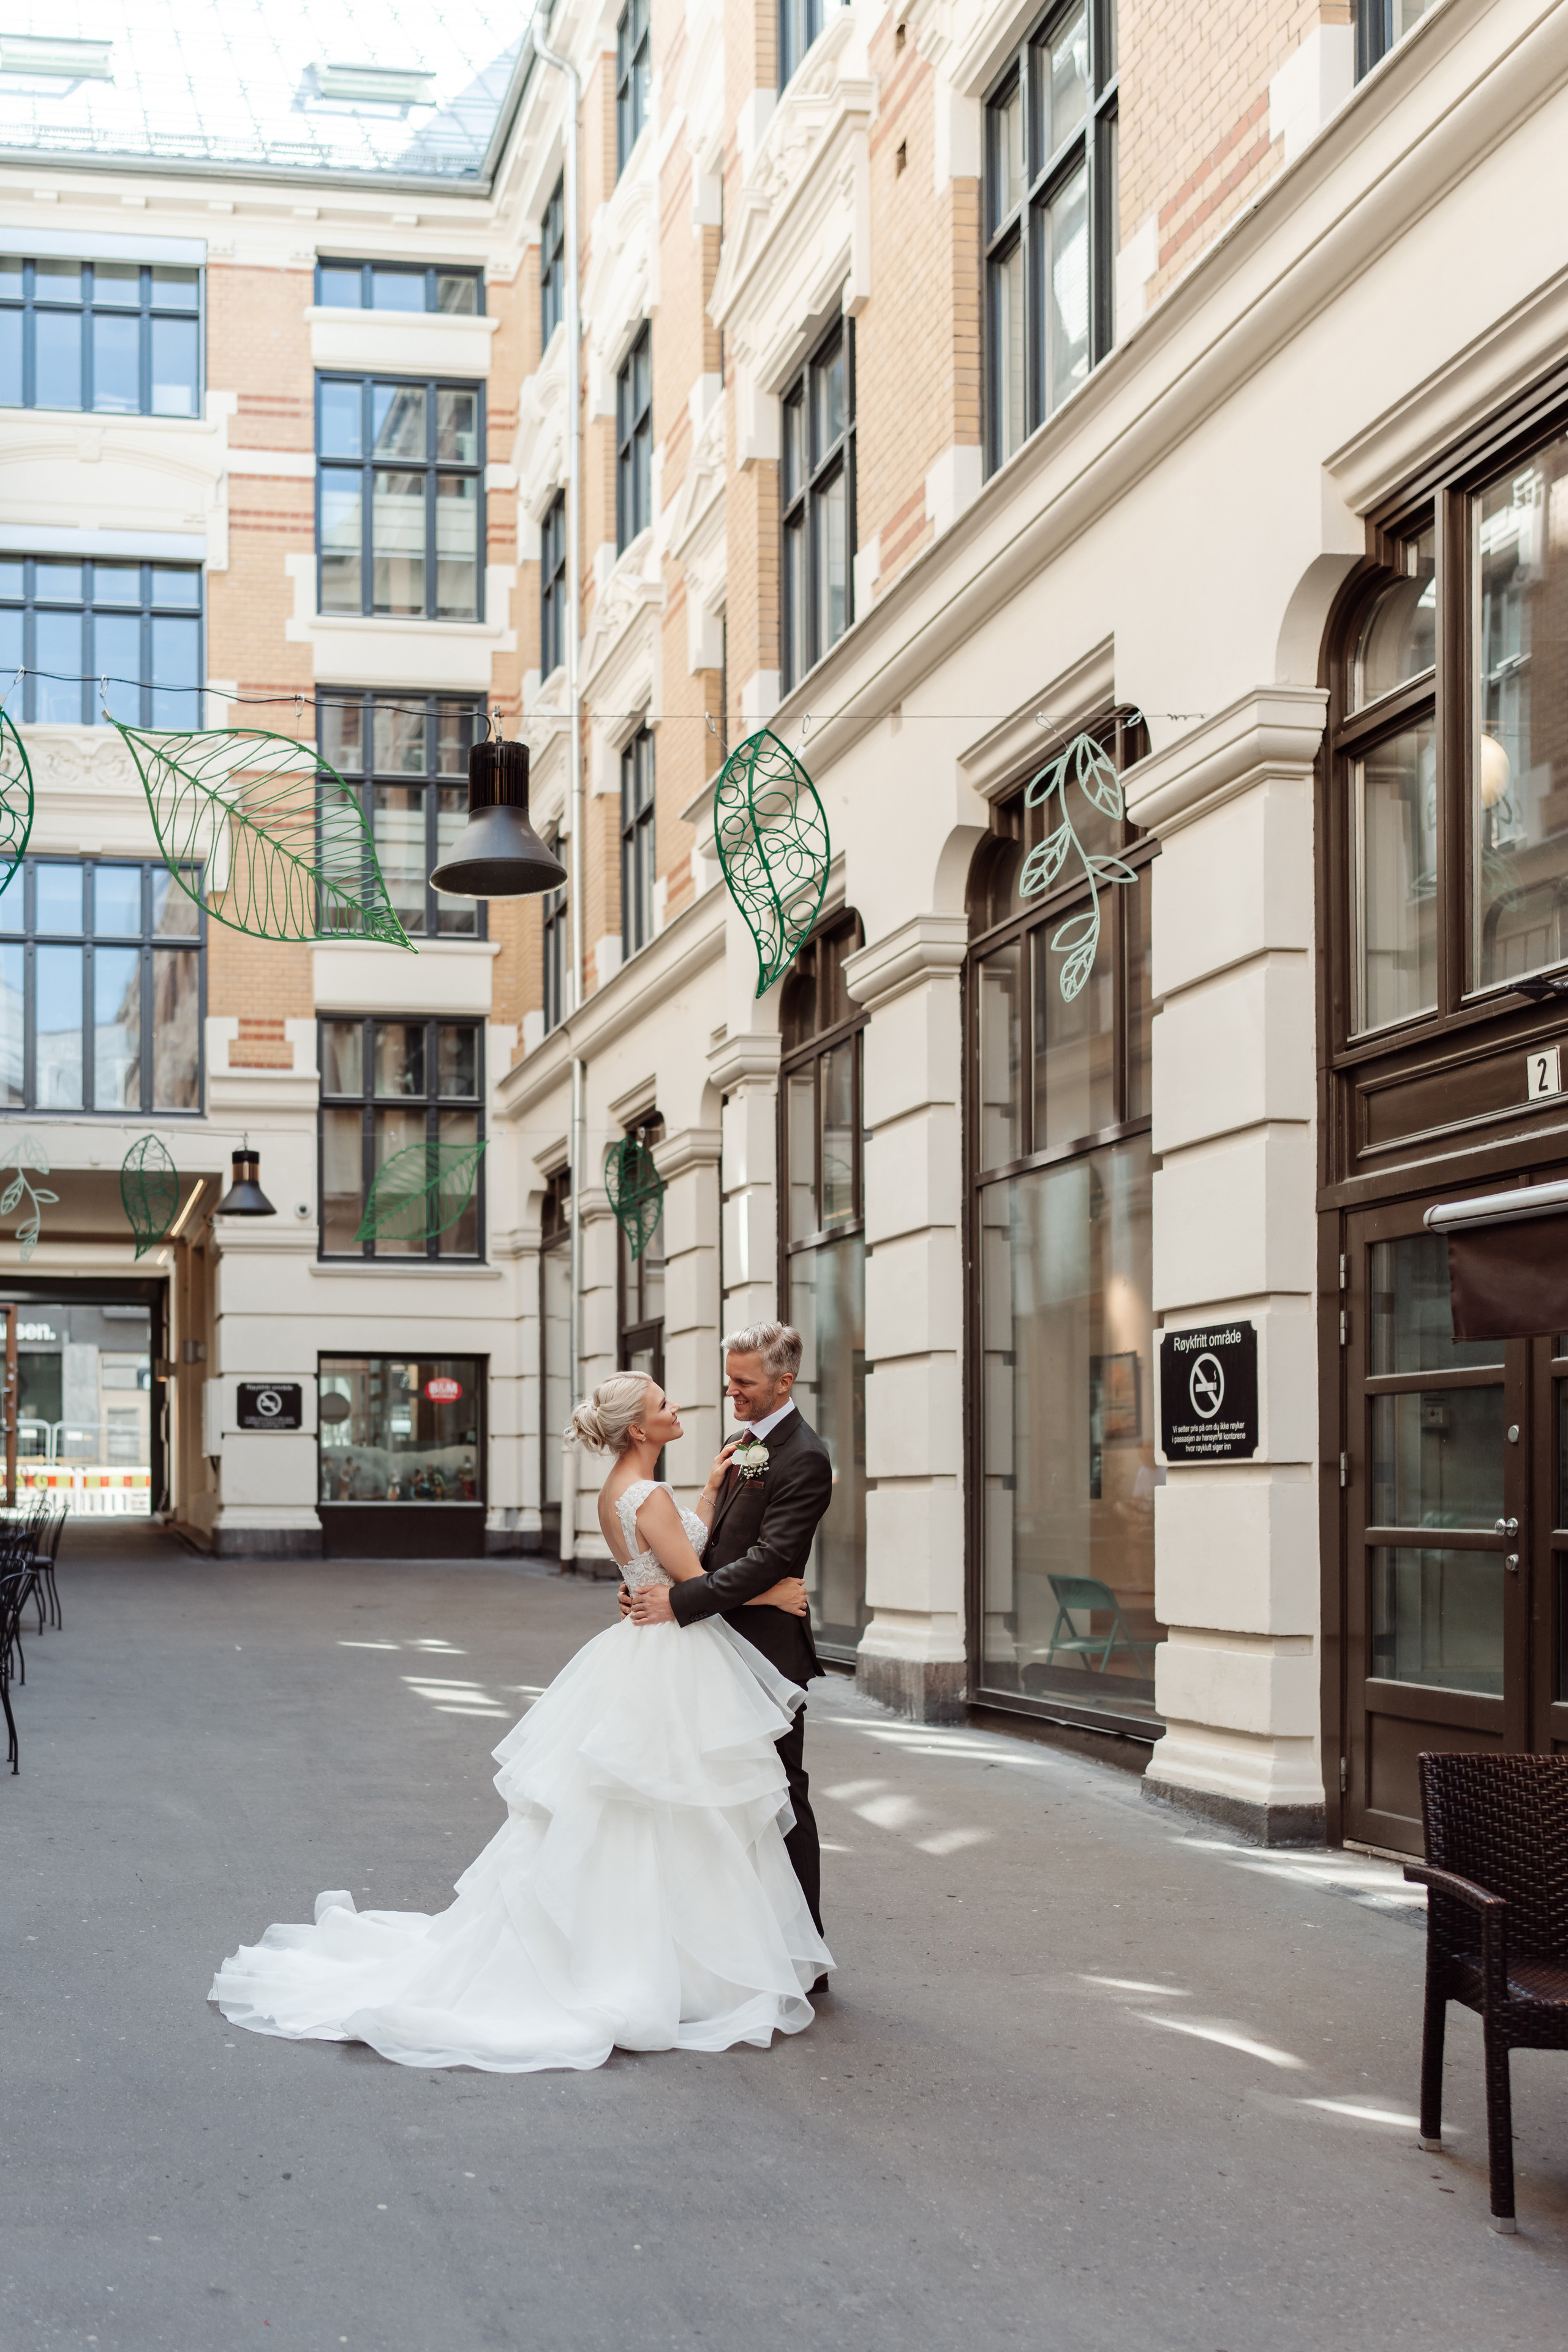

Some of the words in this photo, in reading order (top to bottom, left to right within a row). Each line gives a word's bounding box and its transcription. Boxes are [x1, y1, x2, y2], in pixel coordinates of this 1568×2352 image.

[1537, 1058, 1548, 1091] 2
[1174, 1334, 1207, 1353] Røykfritt
[1208, 1329, 1242, 1346] område
[1190, 1424, 1199, 1433] pris
[1199, 1423, 1205, 1433] på
[1230, 1421, 1245, 1431] røyker
[1174, 1434, 1195, 1444] passasjen
[1202, 1434, 1218, 1442] hensyn
[1196, 1443, 1212, 1453] røykluft
